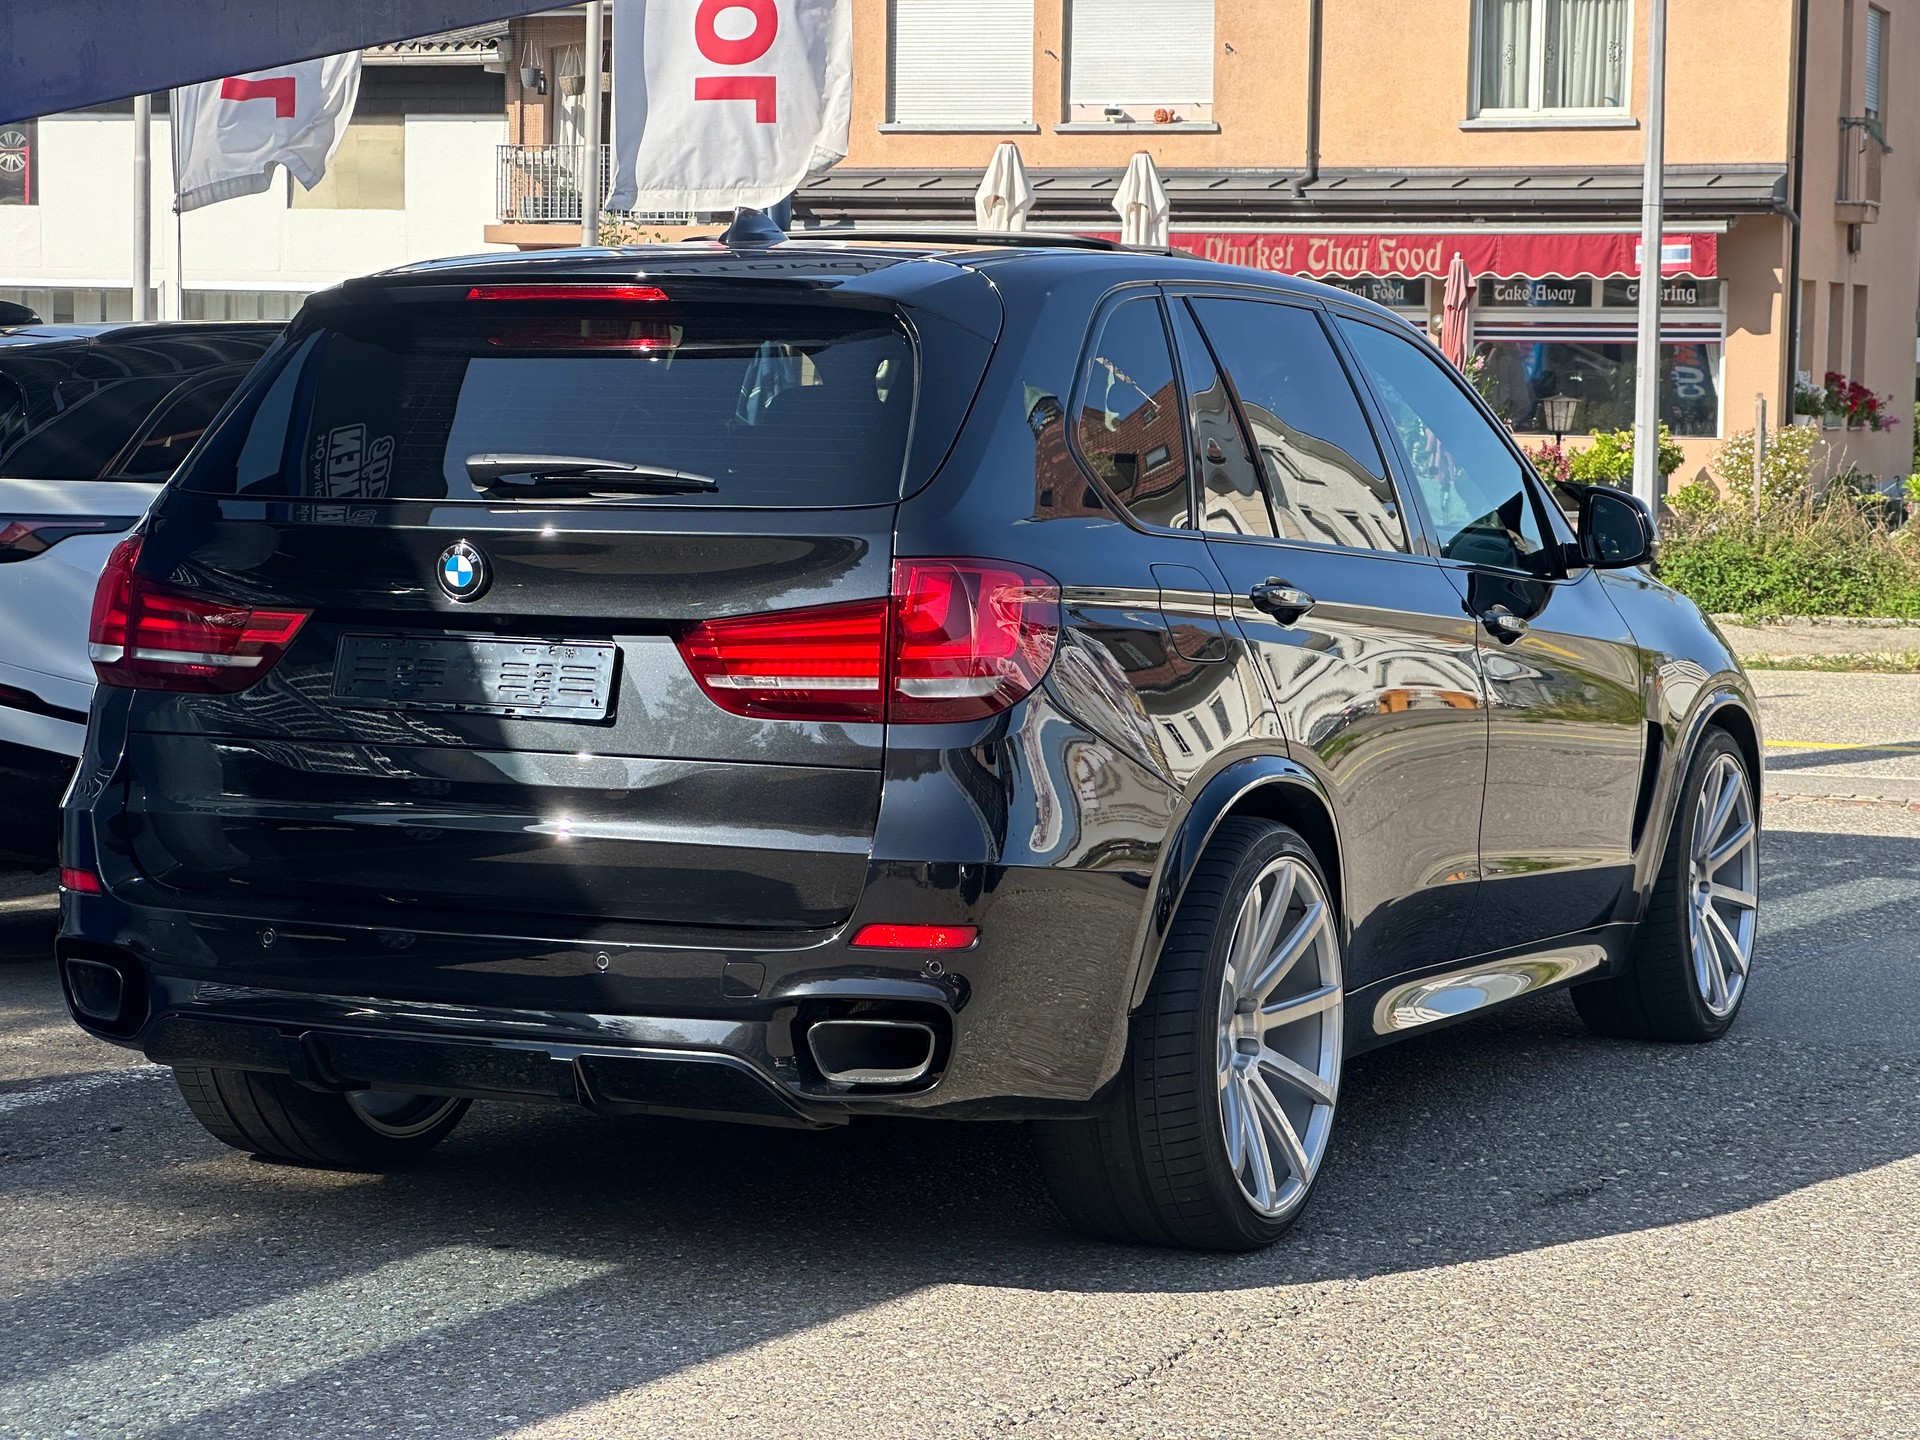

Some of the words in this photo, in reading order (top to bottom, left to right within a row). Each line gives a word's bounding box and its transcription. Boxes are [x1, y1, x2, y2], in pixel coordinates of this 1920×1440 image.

[1204, 237, 1294, 269] Phuket
[1307, 238, 1368, 271] Thai
[1378, 238, 1443, 272] Food
[1372, 284, 1404, 300] Food
[1494, 284, 1530, 301] Take
[1535, 284, 1576, 304] Away
[441, 544, 478, 563] BMW
